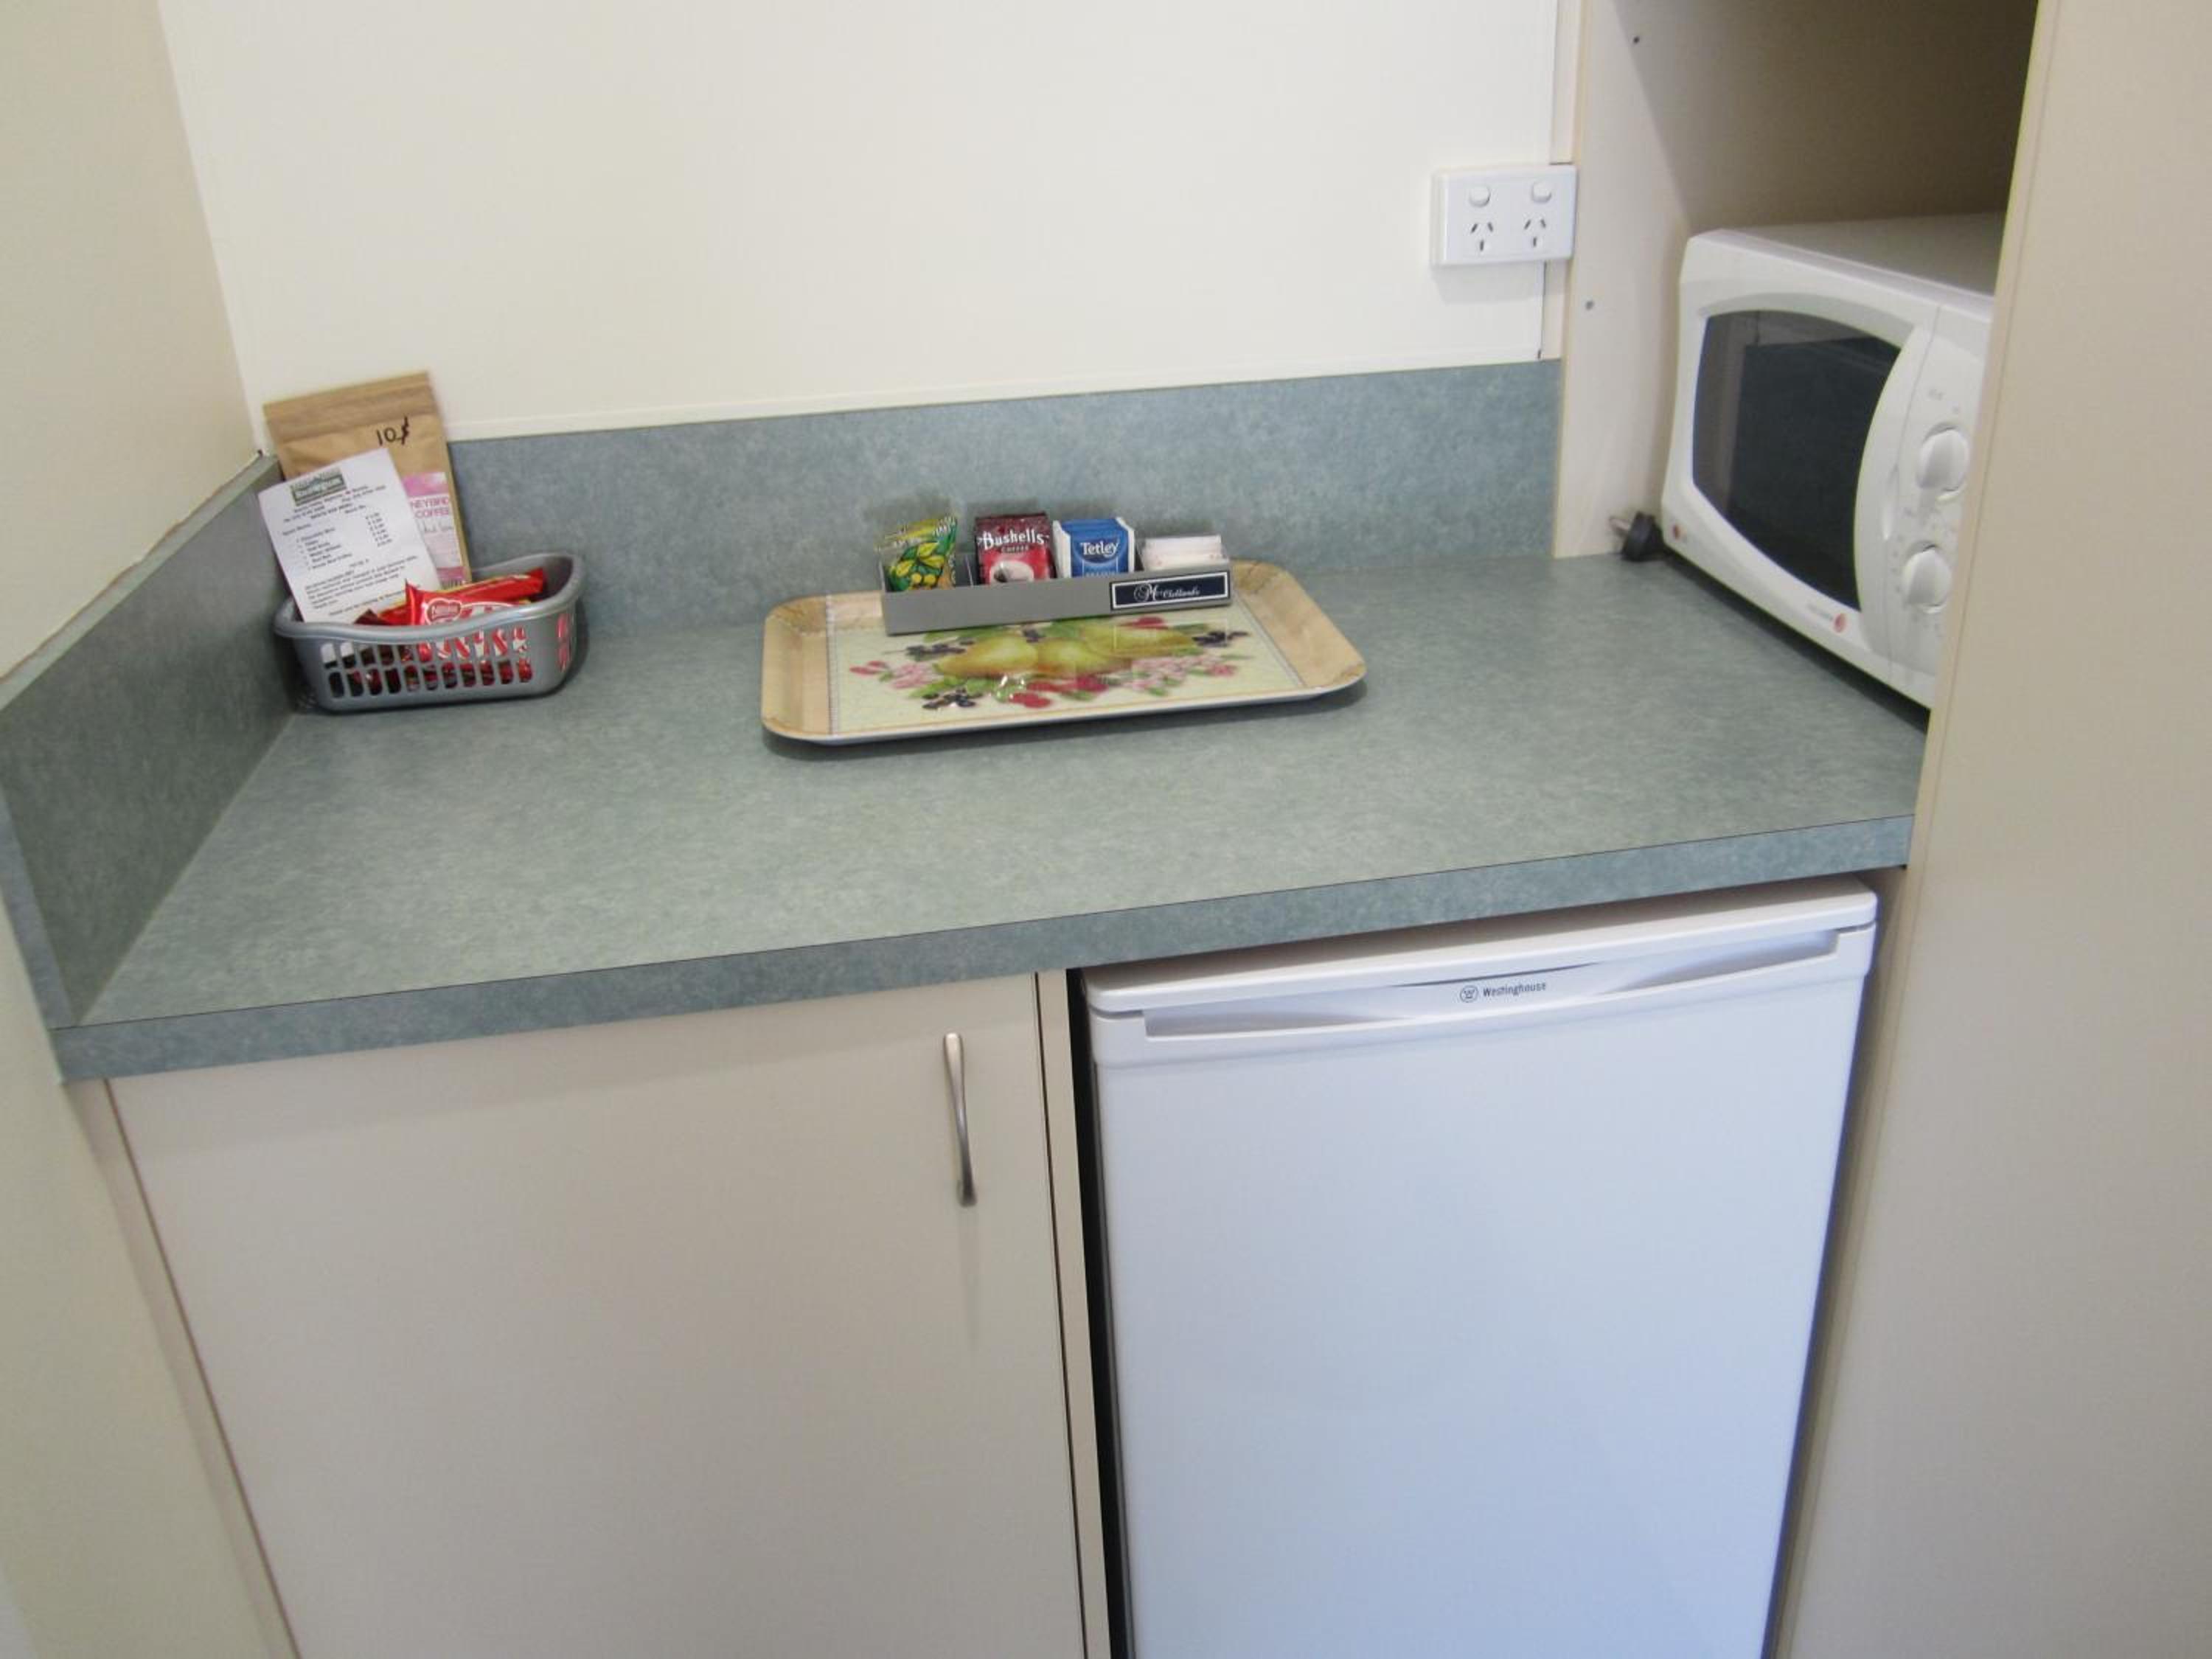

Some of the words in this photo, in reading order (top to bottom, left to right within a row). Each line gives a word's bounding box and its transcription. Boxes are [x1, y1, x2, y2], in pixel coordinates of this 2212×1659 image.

[982, 528, 1045, 551] Bushells
[1079, 539, 1119, 558] Tetley
[1482, 981, 1546, 997] Westinghouse
